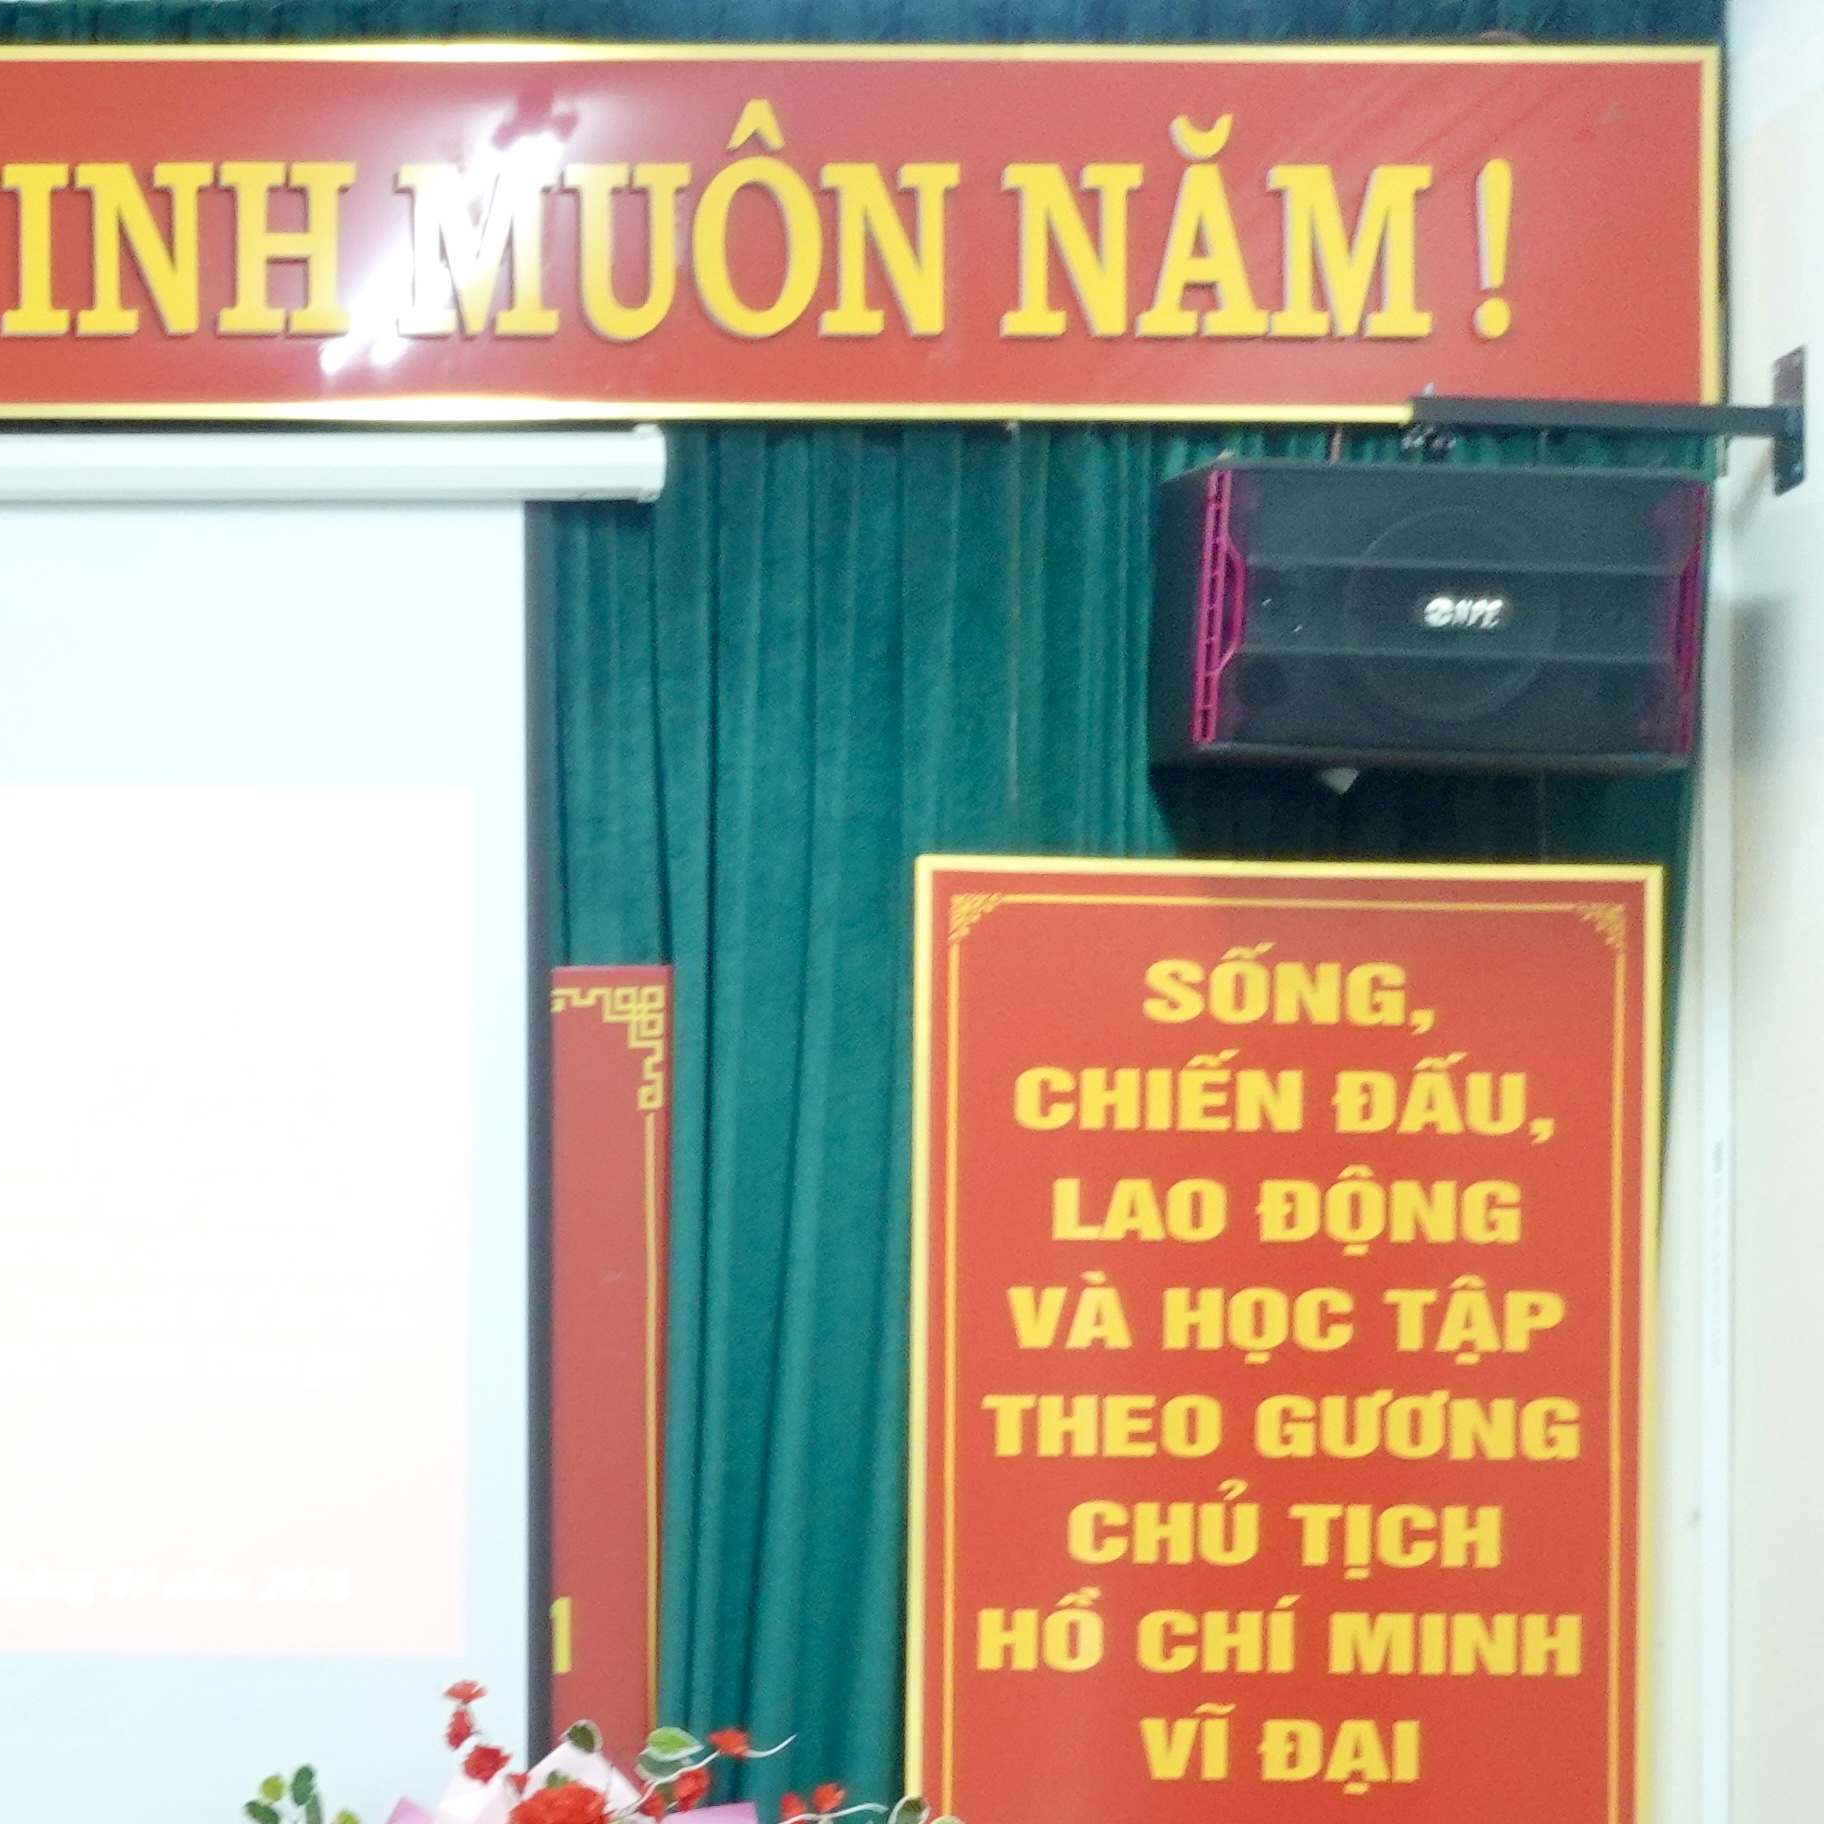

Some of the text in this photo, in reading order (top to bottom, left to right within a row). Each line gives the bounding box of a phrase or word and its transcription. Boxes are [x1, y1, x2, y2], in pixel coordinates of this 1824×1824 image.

[394, 98, 962, 342] MUÔN
[1001, 113, 1434, 338] NĂM
[1143, 942, 1434, 1034] SỐNG,
[1014, 1049, 1554, 1143] CHIẾN ĐẤU,
[1052, 1165, 1521, 1256] LAO ĐỘNG
[1007, 1271, 1565, 1365] VÀ HỌC TẬP
[982, 1389, 1580, 1461] THEO GƯƠNG
[1068, 1479, 1501, 1579] CHỦ TỊCH
[977, 1586, 1581, 1676] HỒ CHÍ MINH
[1140, 1702, 1419, 1794] VĨ ĐẠI
